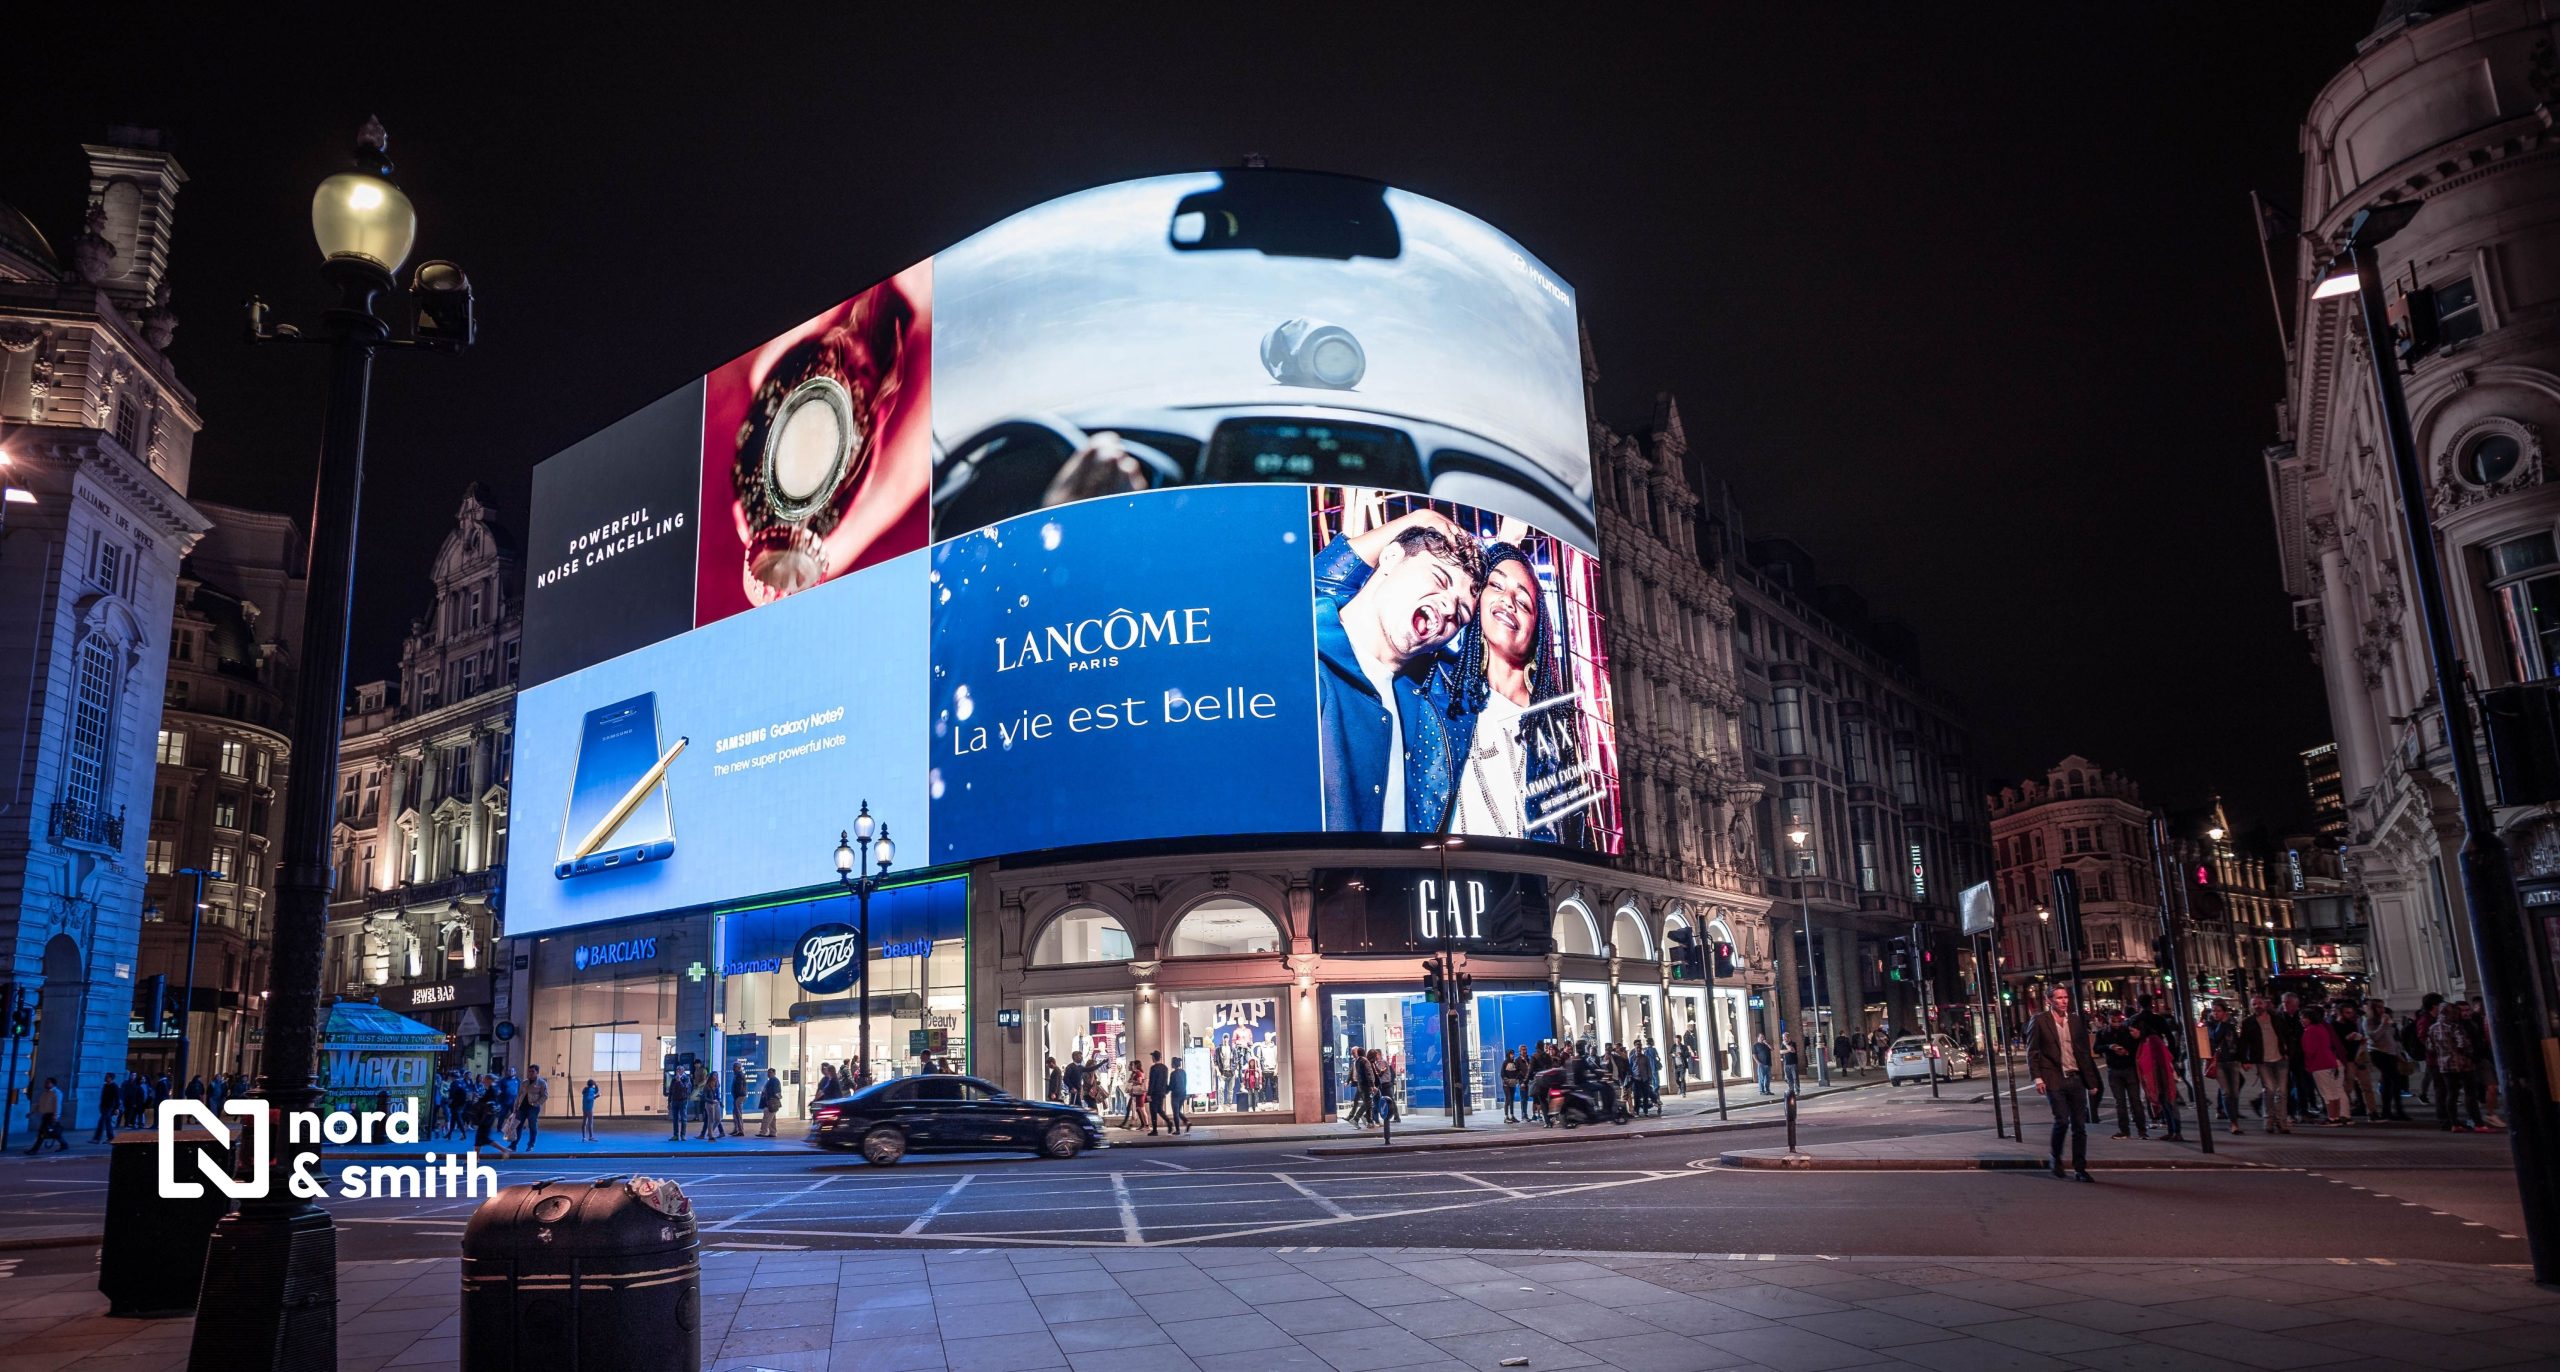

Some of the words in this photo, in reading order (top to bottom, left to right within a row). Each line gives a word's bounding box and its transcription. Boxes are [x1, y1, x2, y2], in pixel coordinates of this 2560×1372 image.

[1529, 265, 1570, 307] HYUNDAI
[78, 485, 111, 518] ALLIANCE
[115, 512, 130, 532] LIFE
[134, 527, 155, 550] OFFICE
[569, 507, 649, 555] POWERFUL
[537, 558, 579, 589] NOISE
[586, 512, 684, 567] CANCELLING
[996, 607, 1212, 673] LANCÔME
[1069, 656, 1120, 673] PARIS
[715, 727, 767, 754] SAMSUNG
[770, 717, 810, 738] Galaxy
[811, 705, 845, 728] Note9
[953, 725, 988, 756] La
[999, 709, 1053, 745] vie
[1068, 697, 1149, 733] est
[1163, 686, 1277, 723] belle
[713, 764, 730, 777] The
[730, 759, 750, 773] new
[751, 751, 777, 768] super
[779, 738, 822, 763] powerful
[823, 734, 846, 749] Note
[1525, 773, 1558, 797] ARMANI
[1559, 762, 1593, 784] EXCHAN
[2291, 856, 2304, 889] LYRIC
[1419, 879, 1486, 939] GAP
[590, 937, 657, 966] BARCLAYS
[722, 957, 782, 977] pharmacy
[797, 932, 856, 983] Boots
[882, 936, 933, 959] beauty
[412, 986, 437, 1005] JEWEL
[437, 985, 455, 1002] BAR
[1213, 1000, 1266, 1030] GAP
[357, 1034, 376, 1042] BEST
[377, 1034, 399, 1042] SHOW
[400, 1034, 409, 1042] IN
[329, 1049, 427, 1089] WICKED
